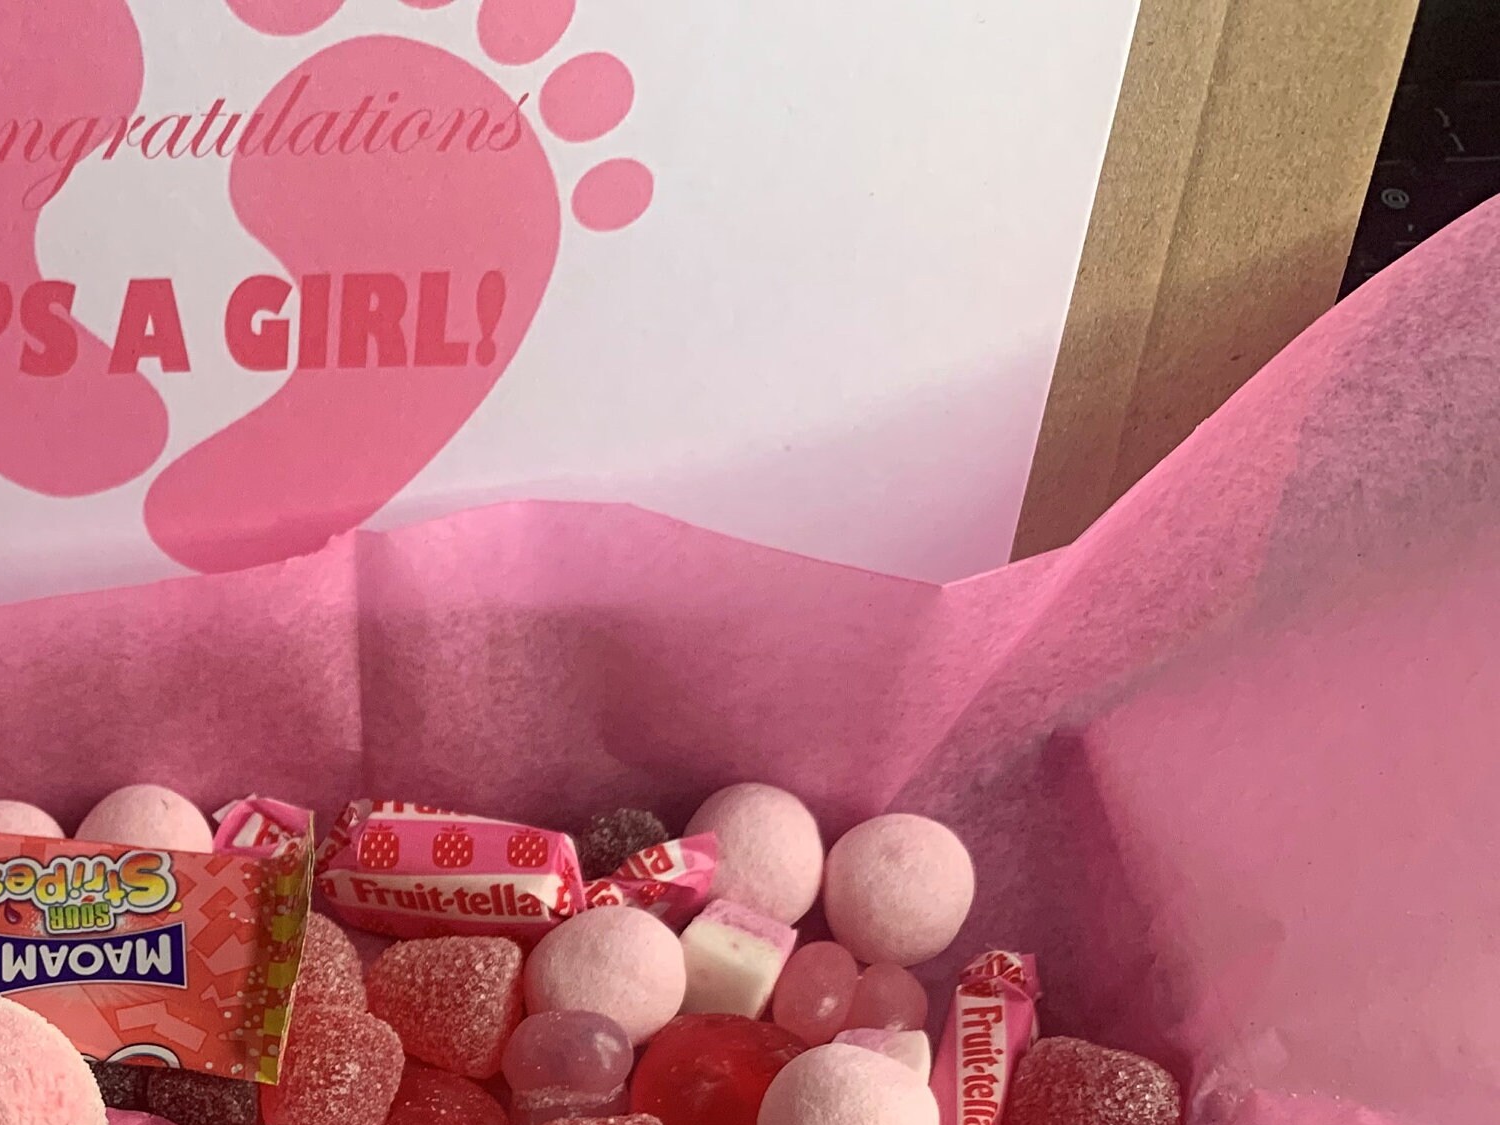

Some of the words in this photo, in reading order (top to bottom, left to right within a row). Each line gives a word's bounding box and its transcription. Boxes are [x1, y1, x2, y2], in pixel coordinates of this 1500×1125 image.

[108, 278, 191, 374] A
[223, 269, 506, 372] GIRL!
[48, 902, 112, 930] SOUR
[350, 877, 545, 917] Fruit-tella
[1, 933, 173, 983] MAOAM
